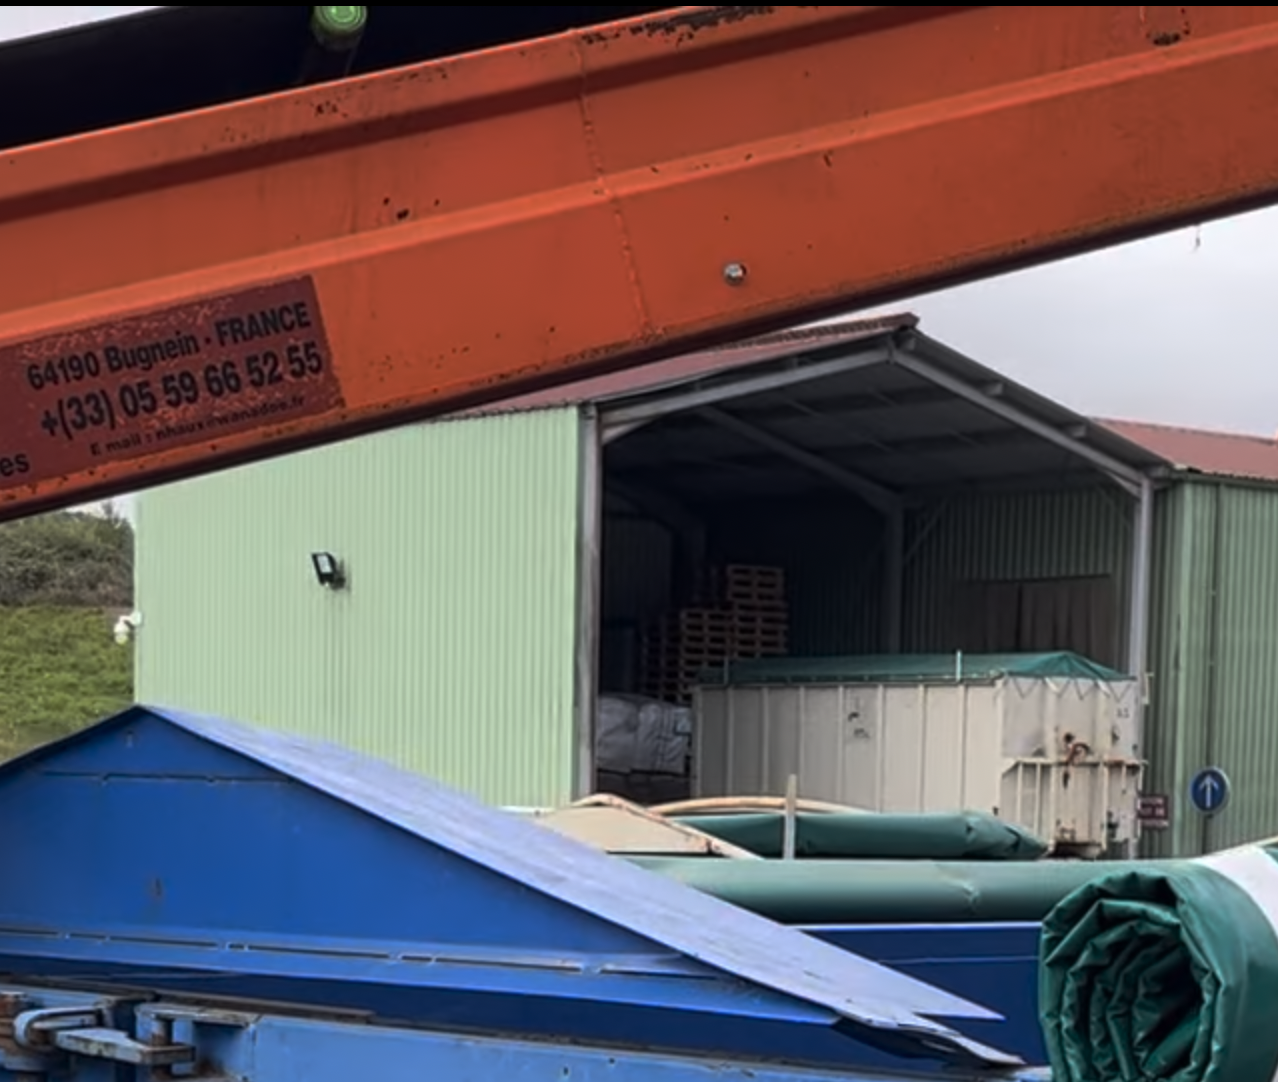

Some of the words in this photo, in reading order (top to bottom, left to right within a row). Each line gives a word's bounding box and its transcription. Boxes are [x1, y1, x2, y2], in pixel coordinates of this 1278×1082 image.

[27, 351, 100, 390] 64190
[105, 330, 200, 373] Bugnein
[216, 302, 311, 347] FRANCE
[41, 389, 116, 440] +(33)
[120, 380, 157, 417] 05
[162, 370, 199, 408] 59
[204, 360, 241, 397] 66
[246, 351, 283, 388] 52
[287, 341, 323, 378] 55
